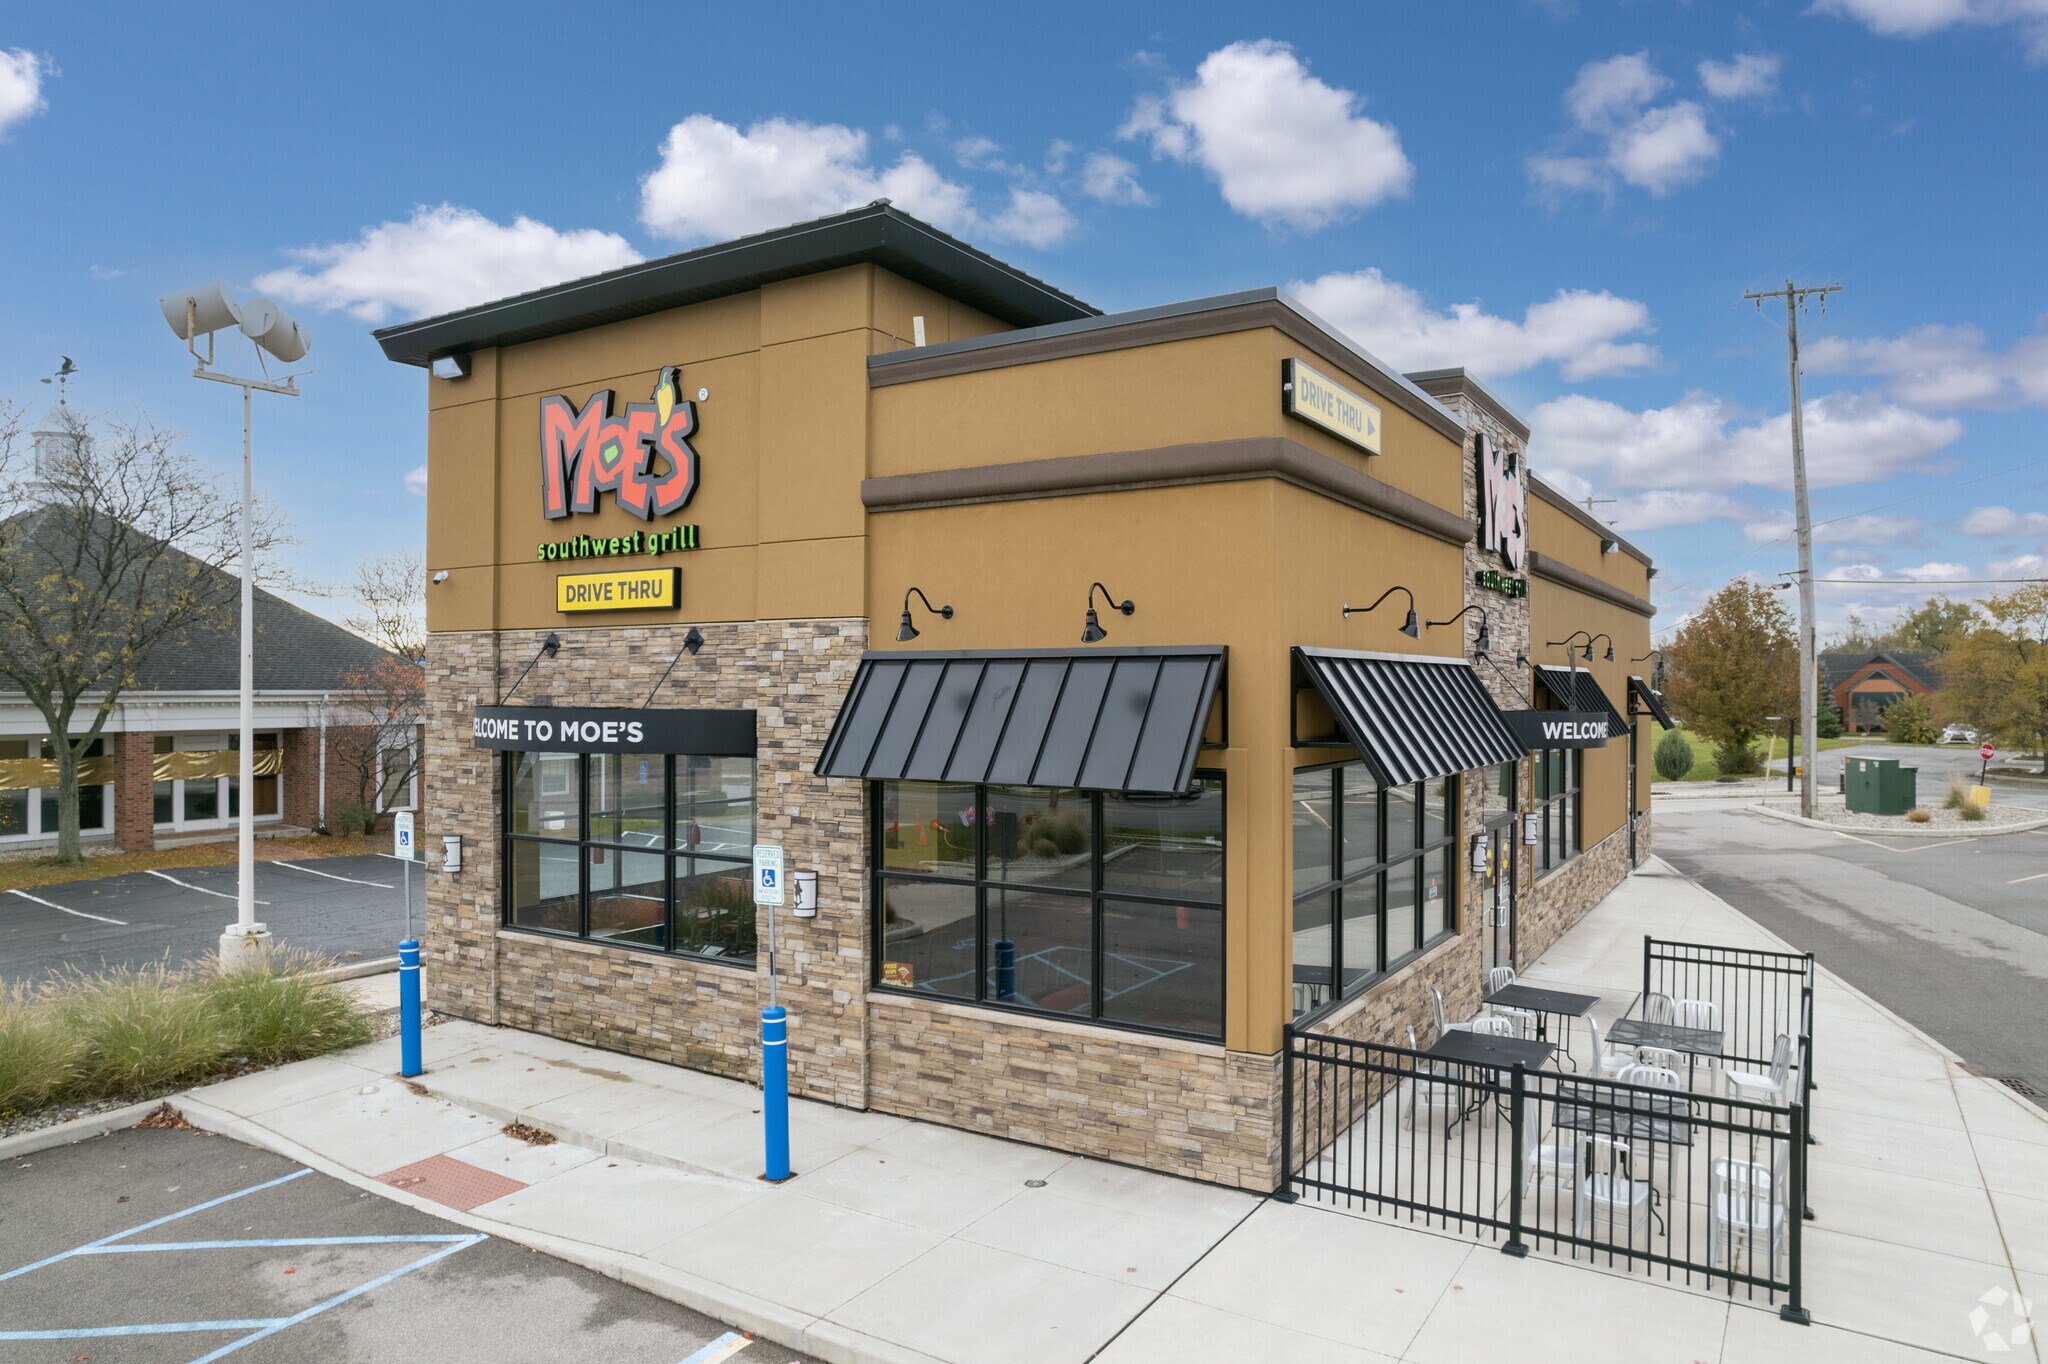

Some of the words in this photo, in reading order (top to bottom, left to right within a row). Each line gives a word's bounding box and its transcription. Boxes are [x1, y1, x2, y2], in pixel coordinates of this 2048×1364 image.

[1301, 376, 1334, 417] DRIVE
[1336, 397, 1362, 433] THRU
[537, 530, 642, 560] southwest
[647, 525, 696, 556] grill
[566, 582, 613, 603] DRIVE
[618, 579, 663, 599] THRU
[473, 718, 519, 741] ELCOME
[524, 720, 553, 742] TO
[560, 721, 644, 743] MOE'S
[1542, 722, 1608, 739] WELCOME
[1980, 748, 1995, 756] STOP
[756, 849, 780, 859] RESERVED
[759, 859, 778, 867] PARKING
